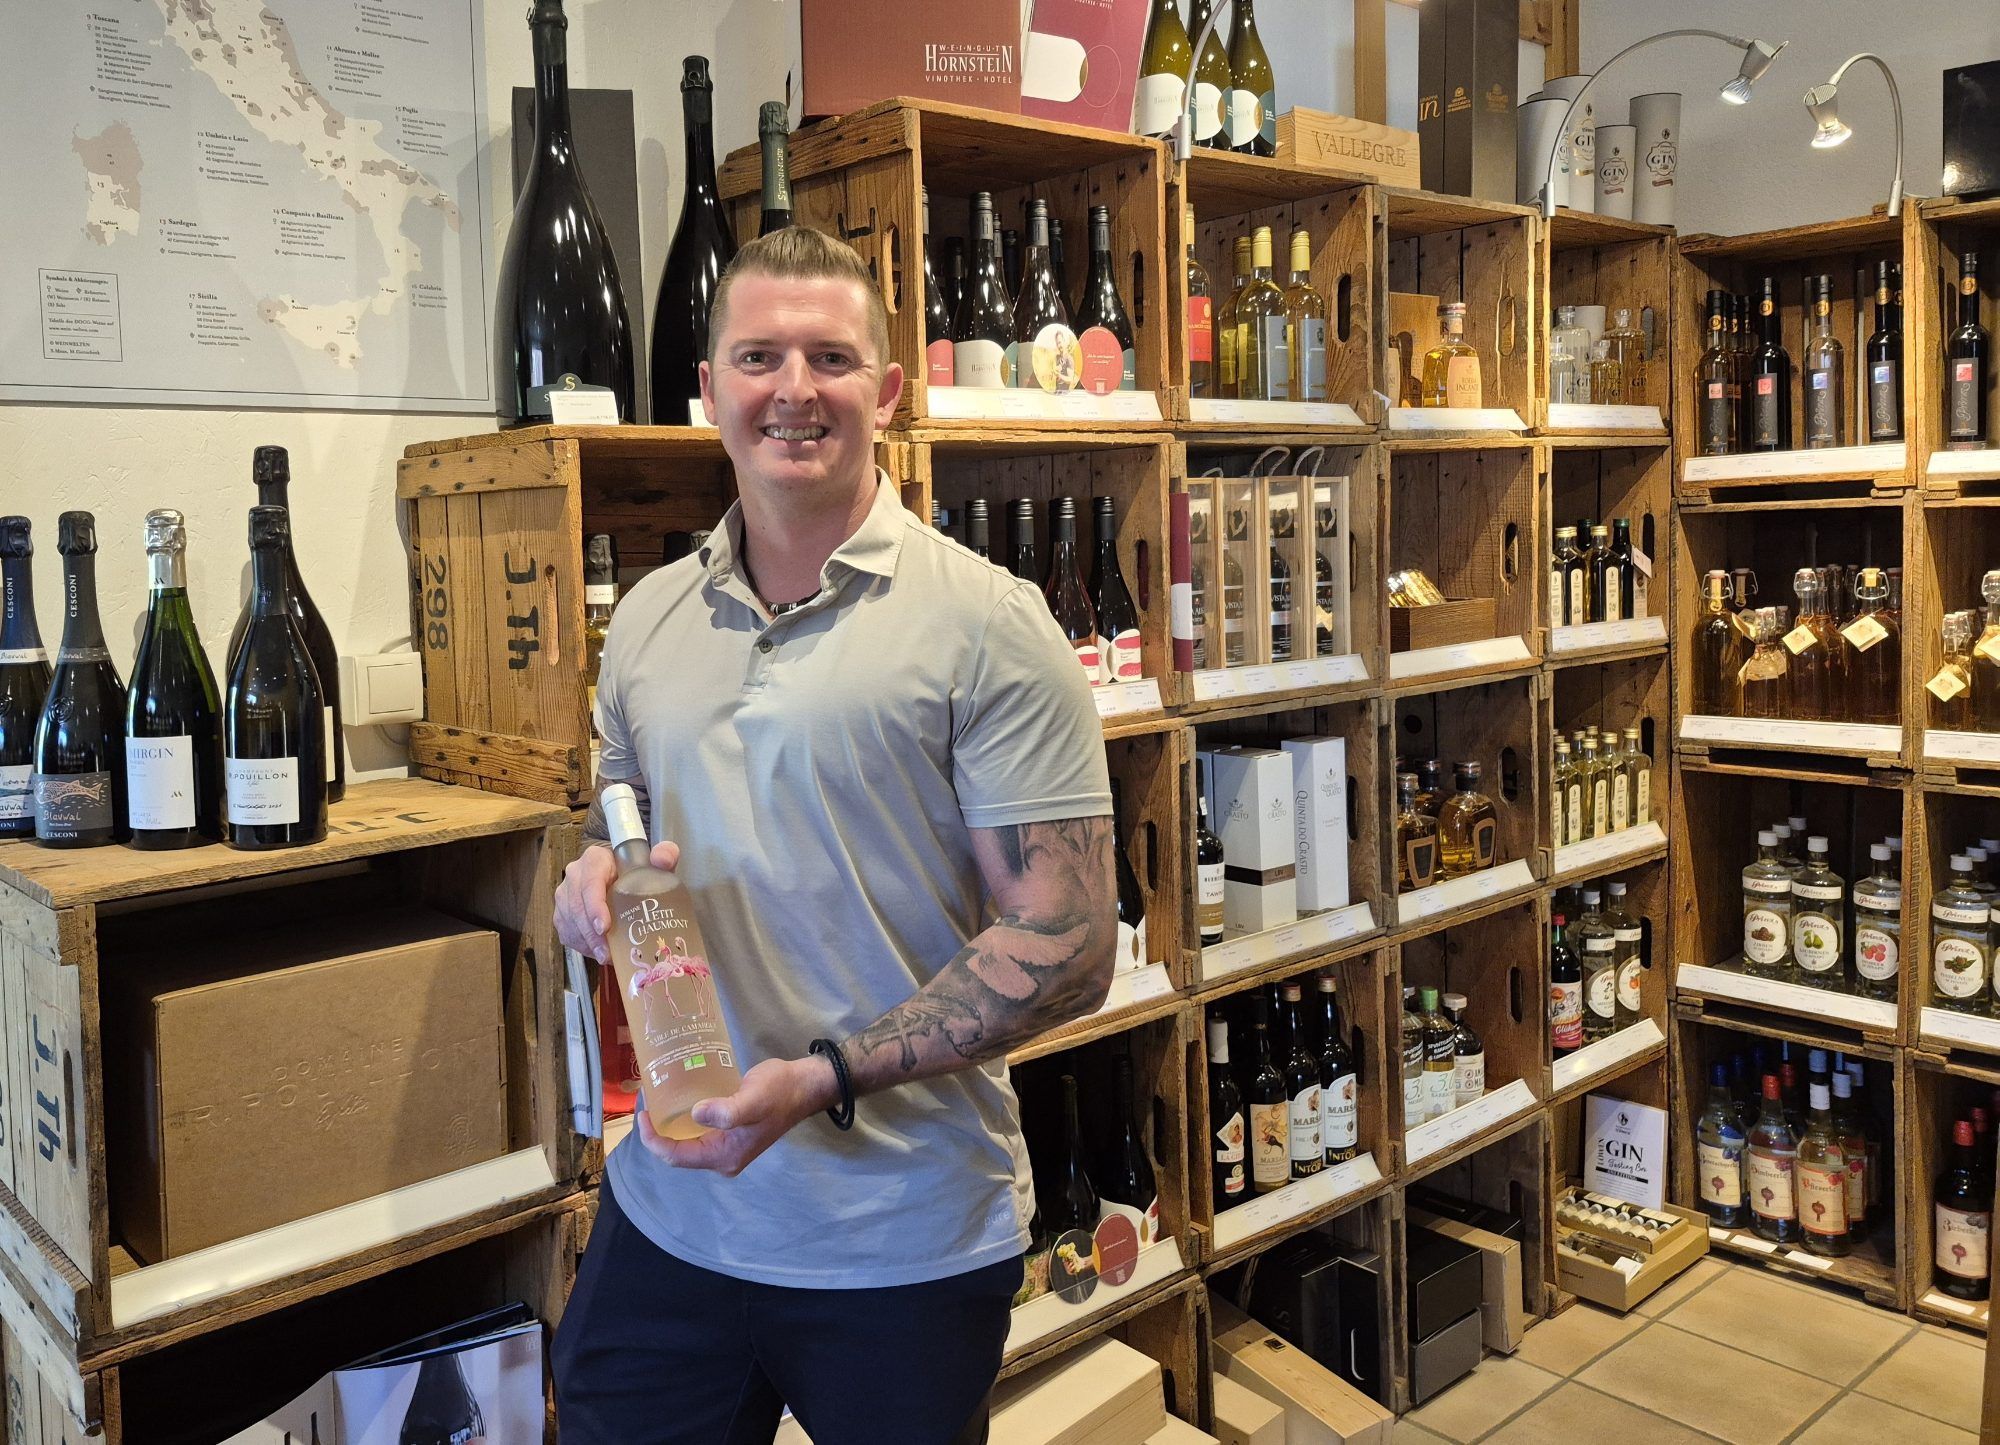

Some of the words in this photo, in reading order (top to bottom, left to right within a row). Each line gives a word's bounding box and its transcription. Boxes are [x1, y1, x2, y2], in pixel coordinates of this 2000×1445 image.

[925, 44, 1012, 73] HORNSTEIN
[1312, 130, 1406, 167] VALLEGRE
[1651, 154, 1675, 164] GIN
[778, 148, 786, 201] STEININGER
[1603, 168, 1625, 177] GIN
[168, 218, 197, 228] Sardegna
[563, 376, 576, 391] S
[504, 551, 536, 600] J.
[425, 554, 448, 650] 298
[507, 605, 539, 669] Th
[43, 810, 81, 820] Blauwal
[1296, 790, 1308, 827] QUINTA
[1299, 827, 1307, 839] DO
[1298, 838, 1310, 875] CRASTO
[620, 905, 641, 919] DOMAINE
[642, 898, 674, 923] PETIT
[628, 918, 689, 945] CHAUMONT
[33, 1014, 57, 1074] J.
[37, 1090, 61, 1162] Th
[1606, 1140, 1644, 1163] GIN
